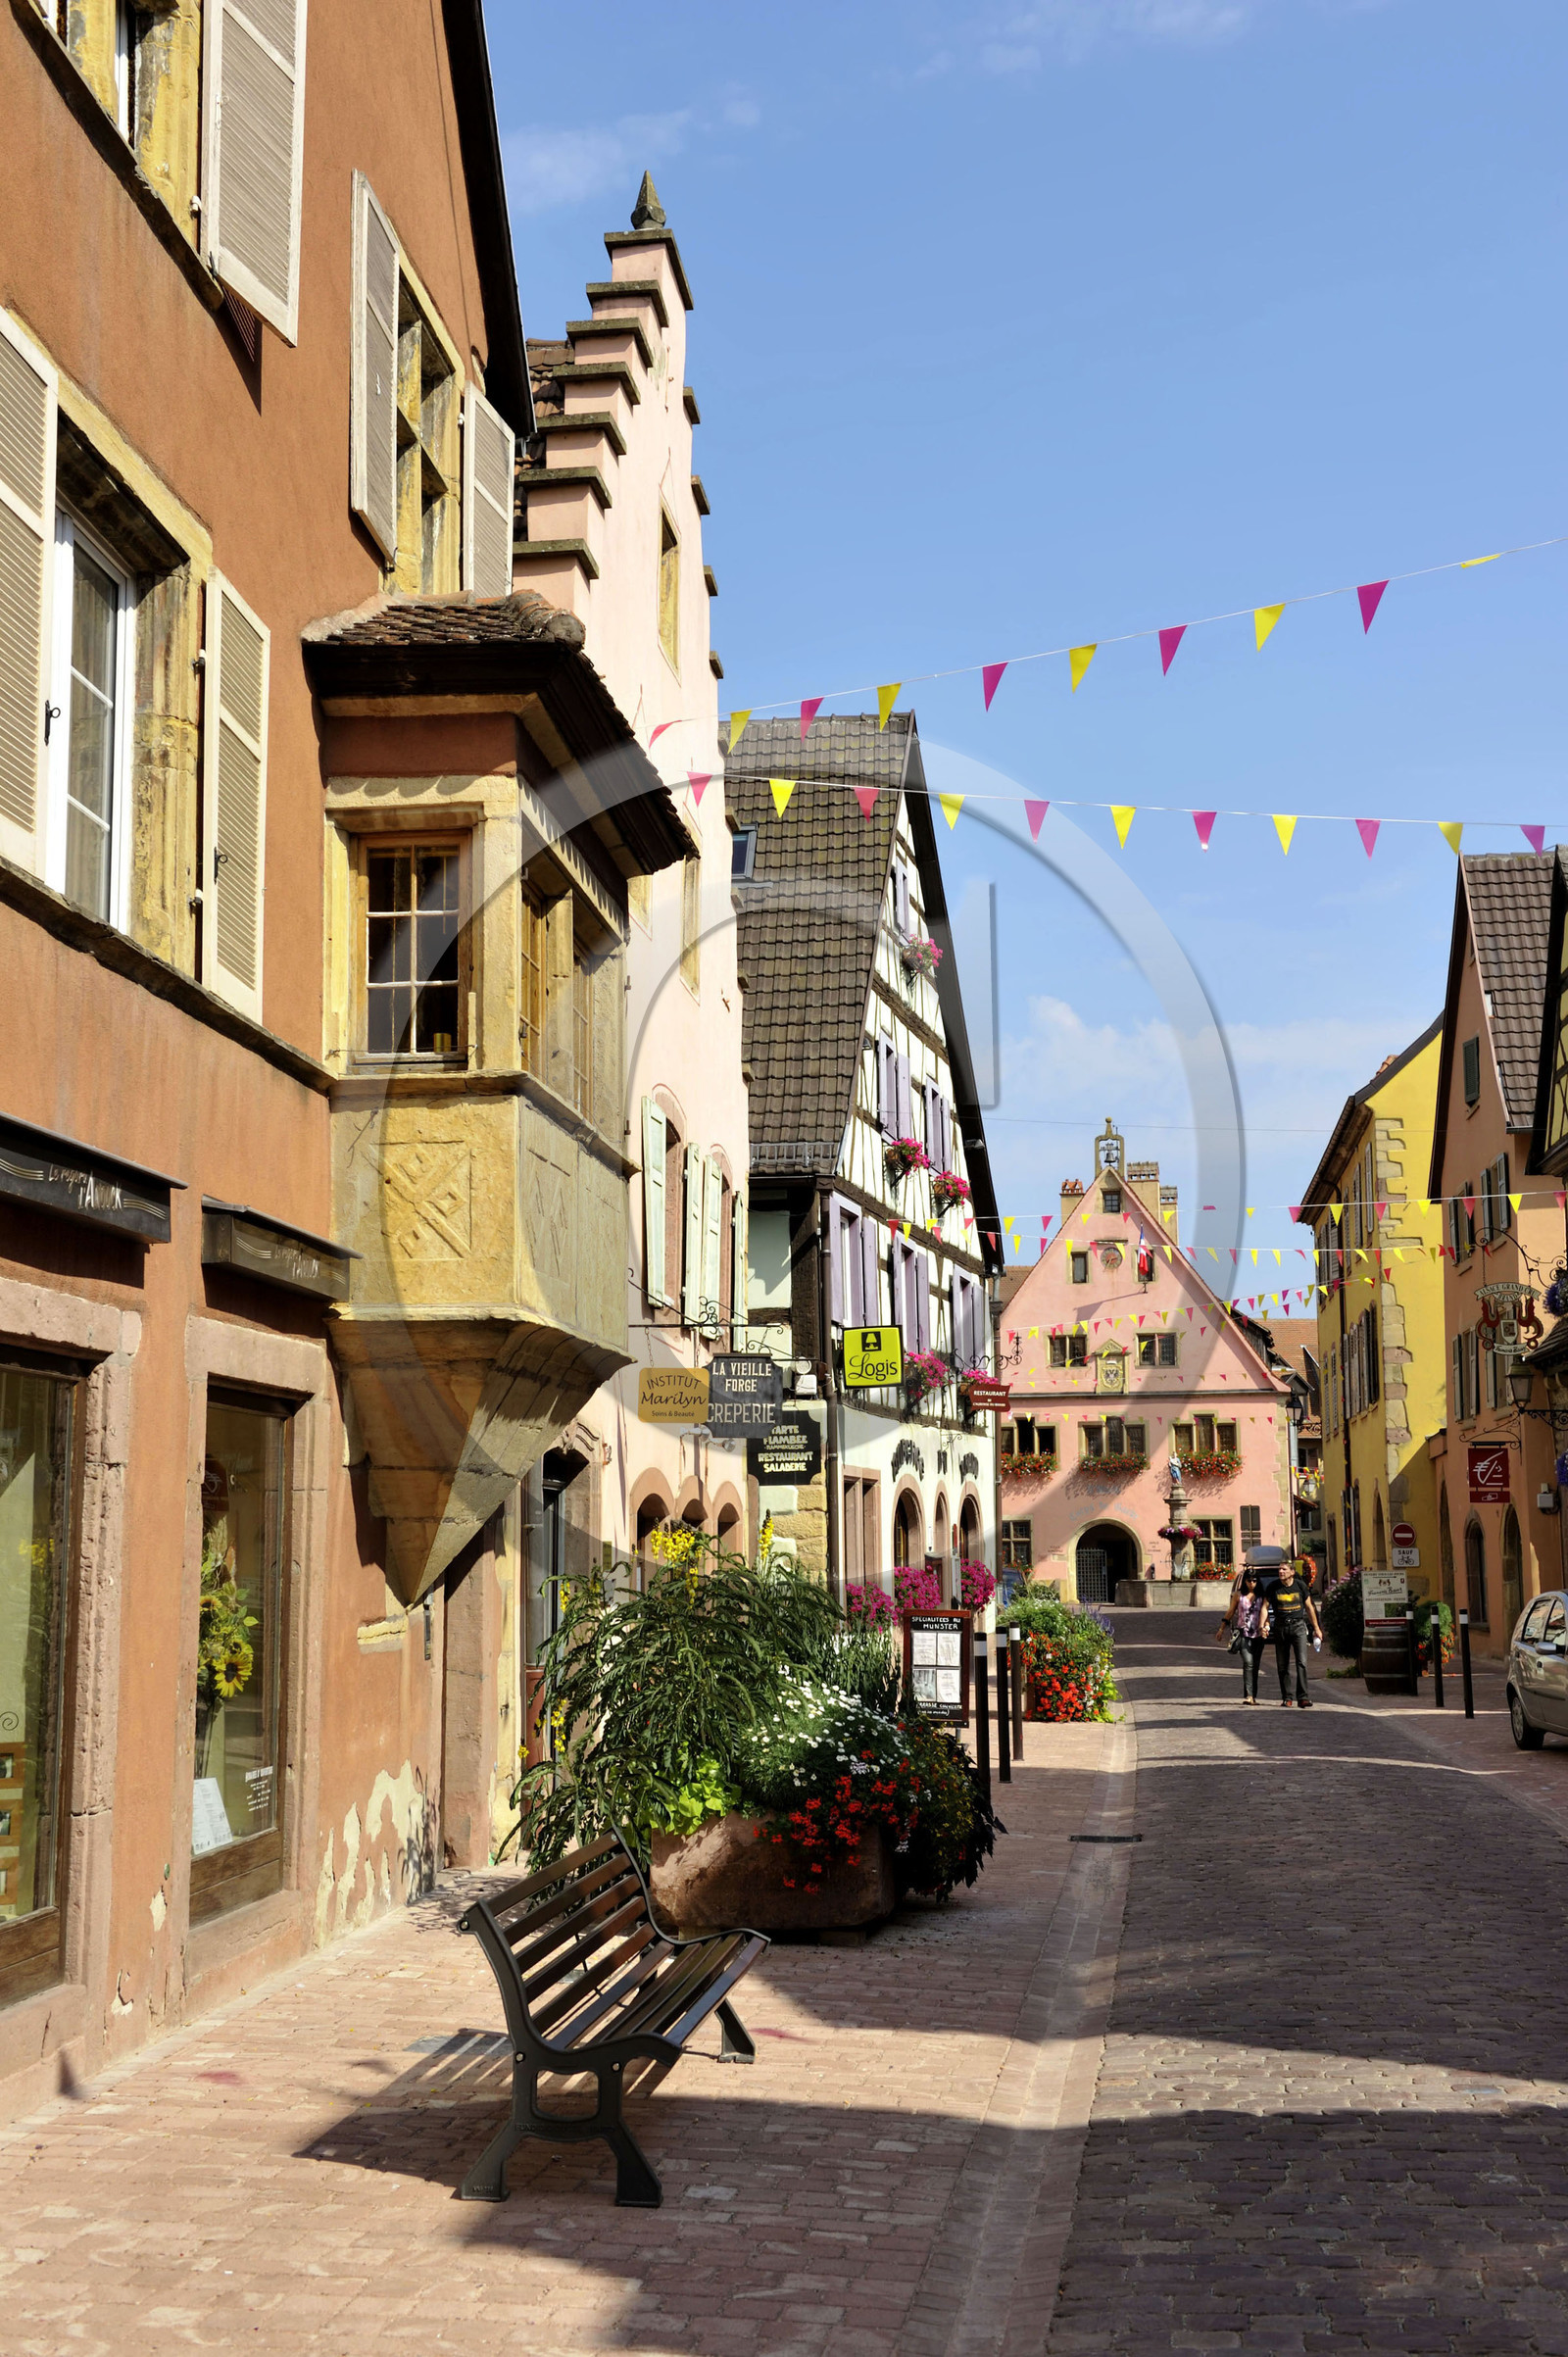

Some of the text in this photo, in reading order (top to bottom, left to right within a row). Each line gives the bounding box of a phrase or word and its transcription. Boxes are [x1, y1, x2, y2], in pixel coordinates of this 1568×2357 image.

[1479, 1283, 1536, 1296] ALSACE GRAND CRU
[712, 1361, 772, 1377] LA VIEILLE
[848, 1352, 898, 1382] Logis
[647, 1374, 702, 1390] INSTITUT
[725, 1379, 758, 1393] FORGE
[641, 1392, 707, 1408] Marilyn
[707, 1402, 776, 1424] CREPERIE
[758, 1451, 813, 1462] RESTAURANT
[763, 1462, 808, 1473] SALADERIE
